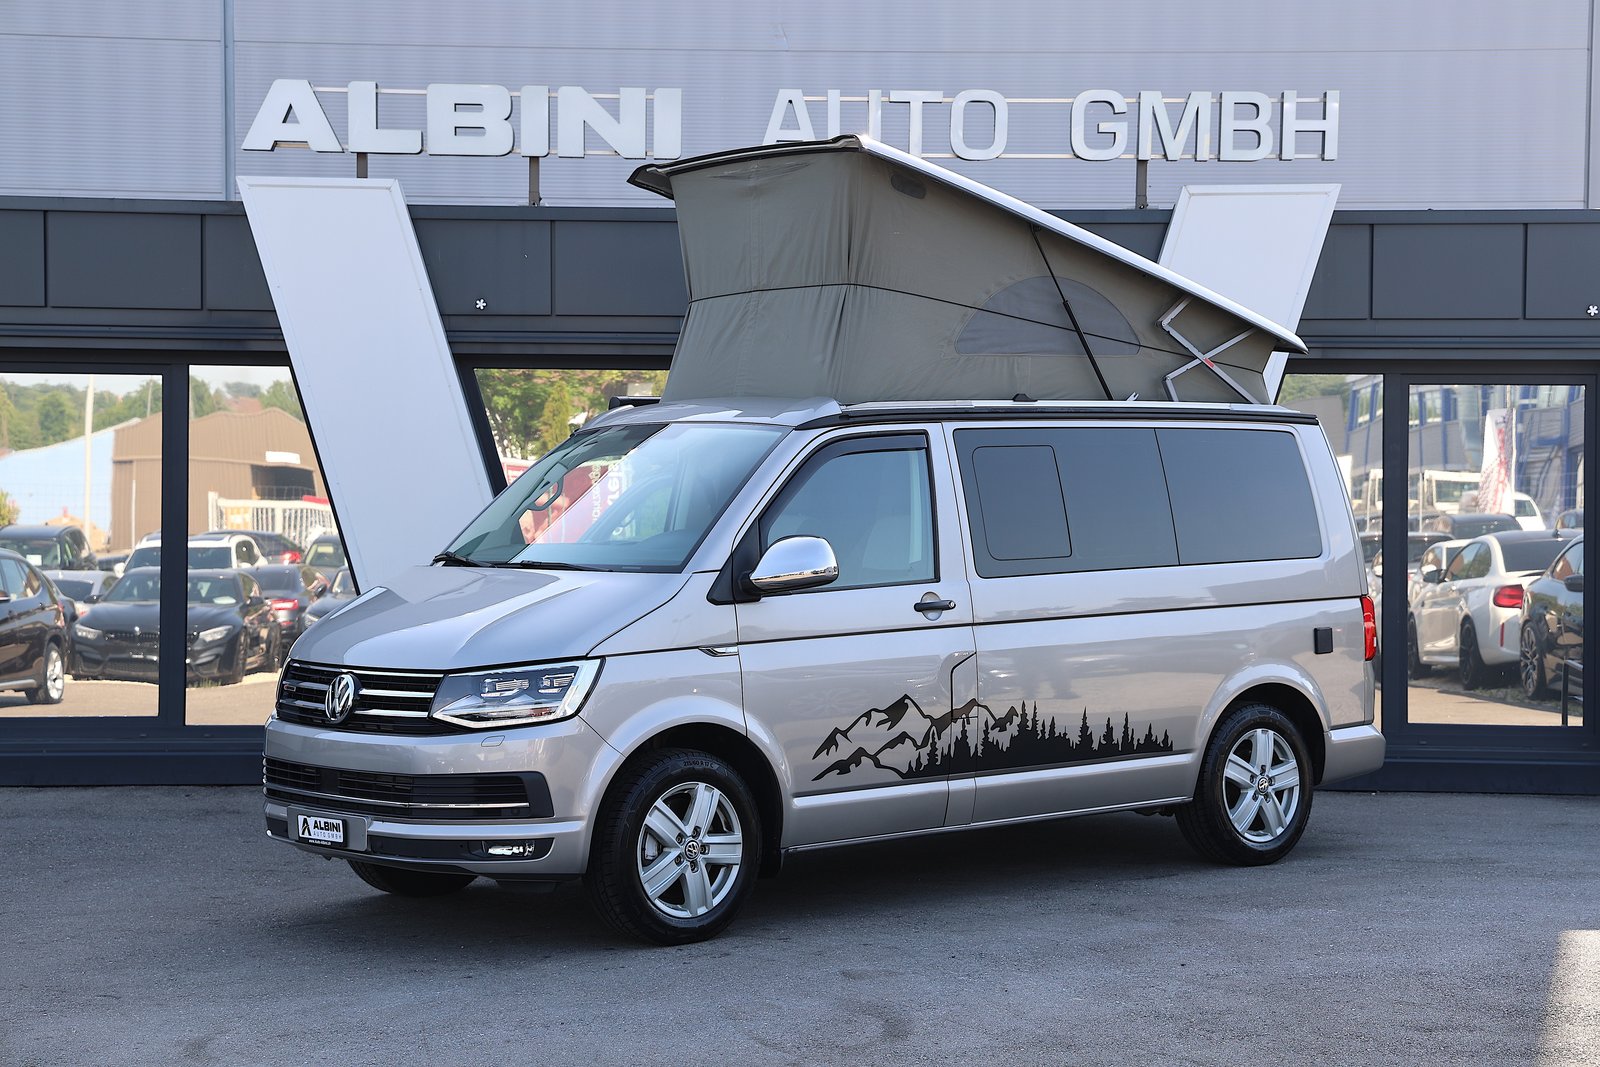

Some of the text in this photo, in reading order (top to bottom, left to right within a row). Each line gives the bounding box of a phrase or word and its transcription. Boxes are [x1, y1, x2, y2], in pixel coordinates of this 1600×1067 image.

[241, 79, 1340, 162] ALBINI AUTO GMBH
[313, 819, 342, 833] ALBINI
